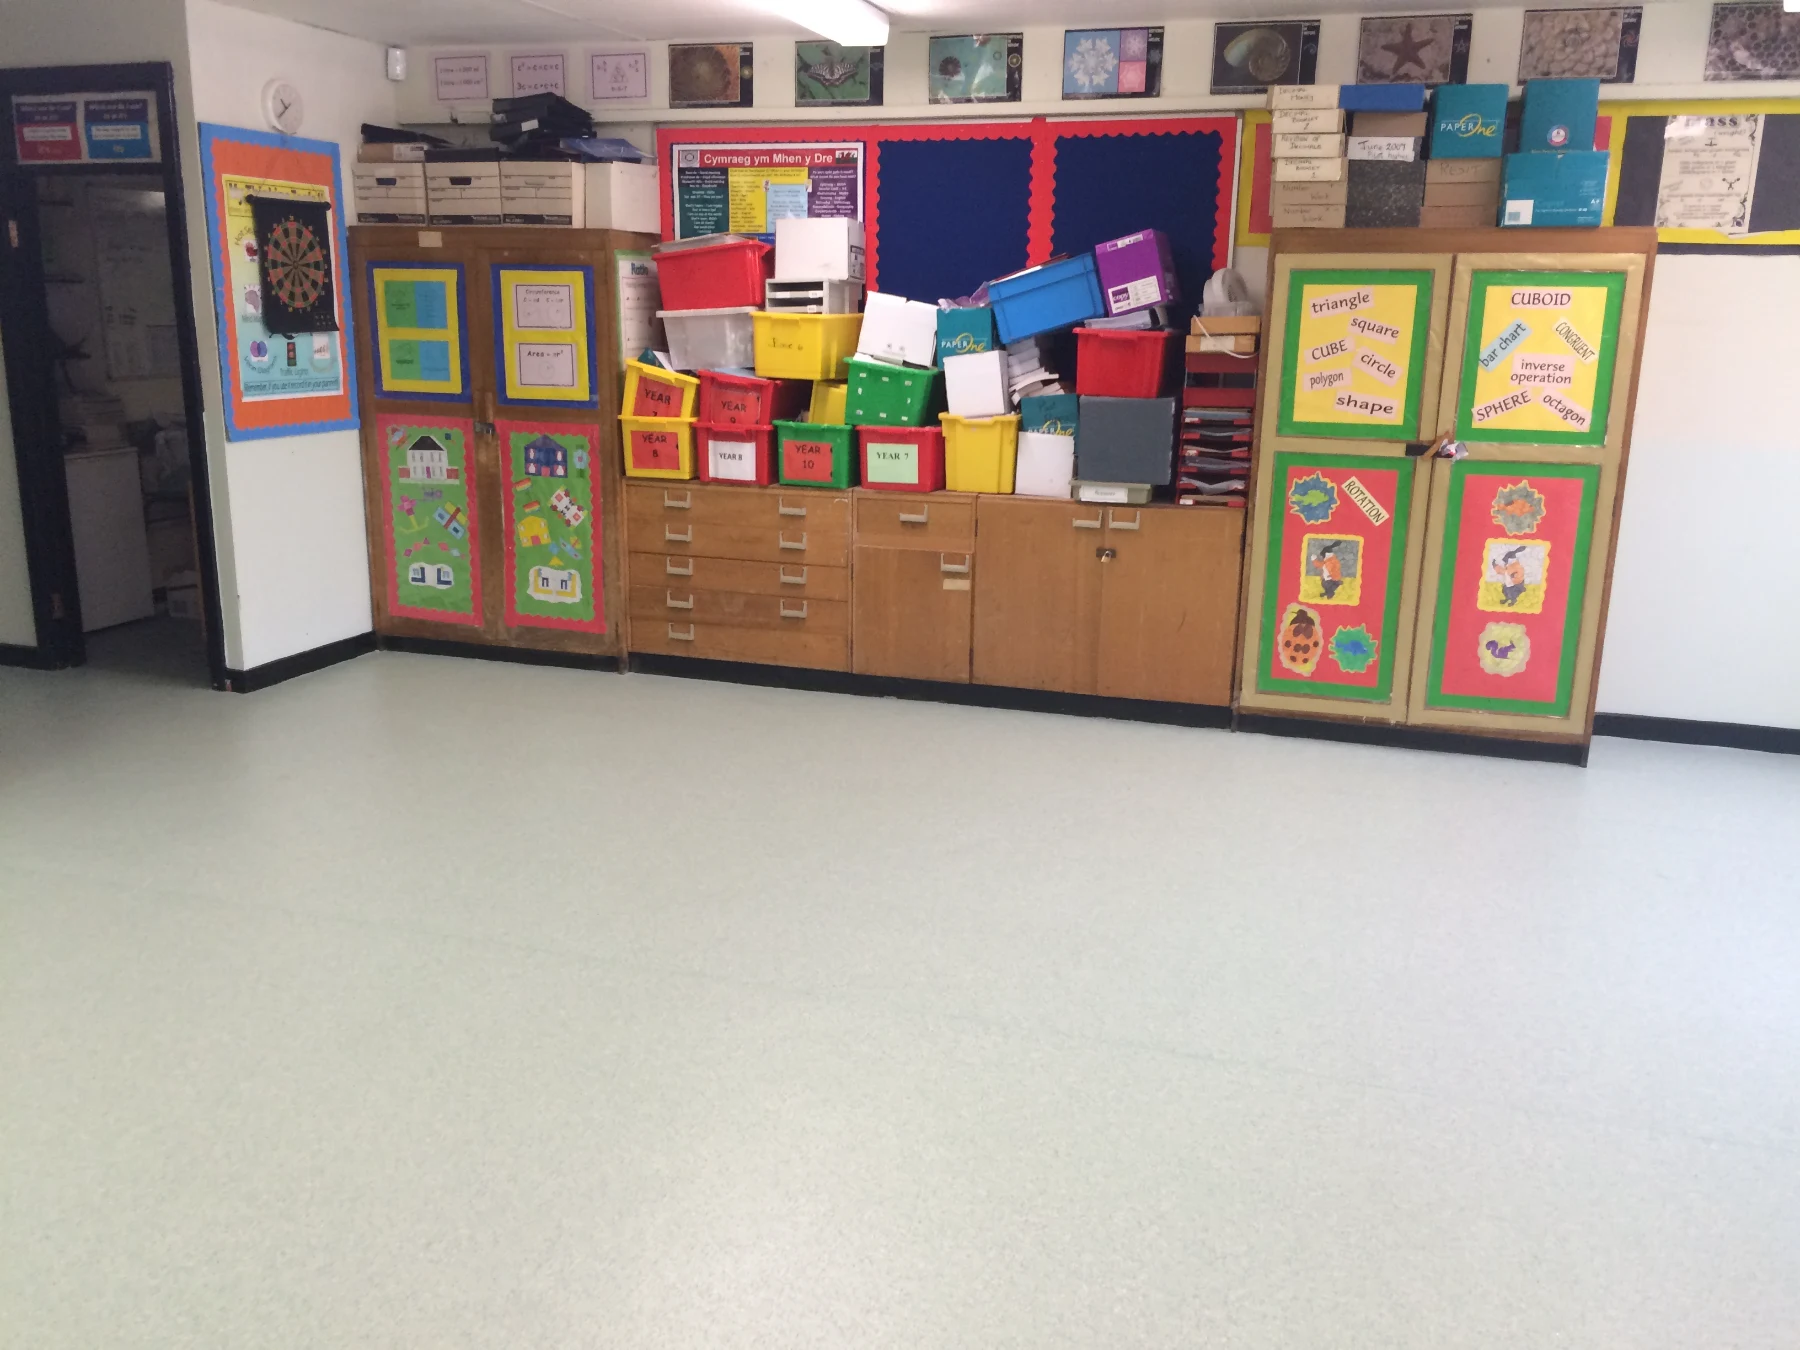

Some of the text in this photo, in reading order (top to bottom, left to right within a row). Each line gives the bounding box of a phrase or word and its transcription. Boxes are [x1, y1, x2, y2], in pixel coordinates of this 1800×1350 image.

[704, 151, 833, 166] Cymraeg ym Mhen y Dre
[1312, 292, 1370, 313] triangle
[1511, 292, 1571, 306] CUBOID
[1351, 318, 1399, 338] square
[1312, 340, 1348, 360] CUBE
[1479, 323, 1526, 368] bar chart
[1555, 322, 1596, 361] CONGRUENT
[1360, 354, 1396, 378] circle
[1521, 359, 1565, 372] inverse
[1310, 372, 1344, 389] polygon
[1510, 373, 1572, 385] operation
[645, 388, 671, 405] YEAR
[1336, 395, 1394, 414] shape
[721, 401, 747, 412] YEAR
[1476, 390, 1531, 422] SPHERE
[1543, 395, 1586, 426] octagon
[642, 434, 667, 443] YEAR
[719, 452, 736, 461] YEAR
[795, 444, 821, 454] YEAR
[876, 451, 909, 460] YEAR 7
[803, 460, 814, 469] 10
[1345, 480, 1385, 523] ROTATION
